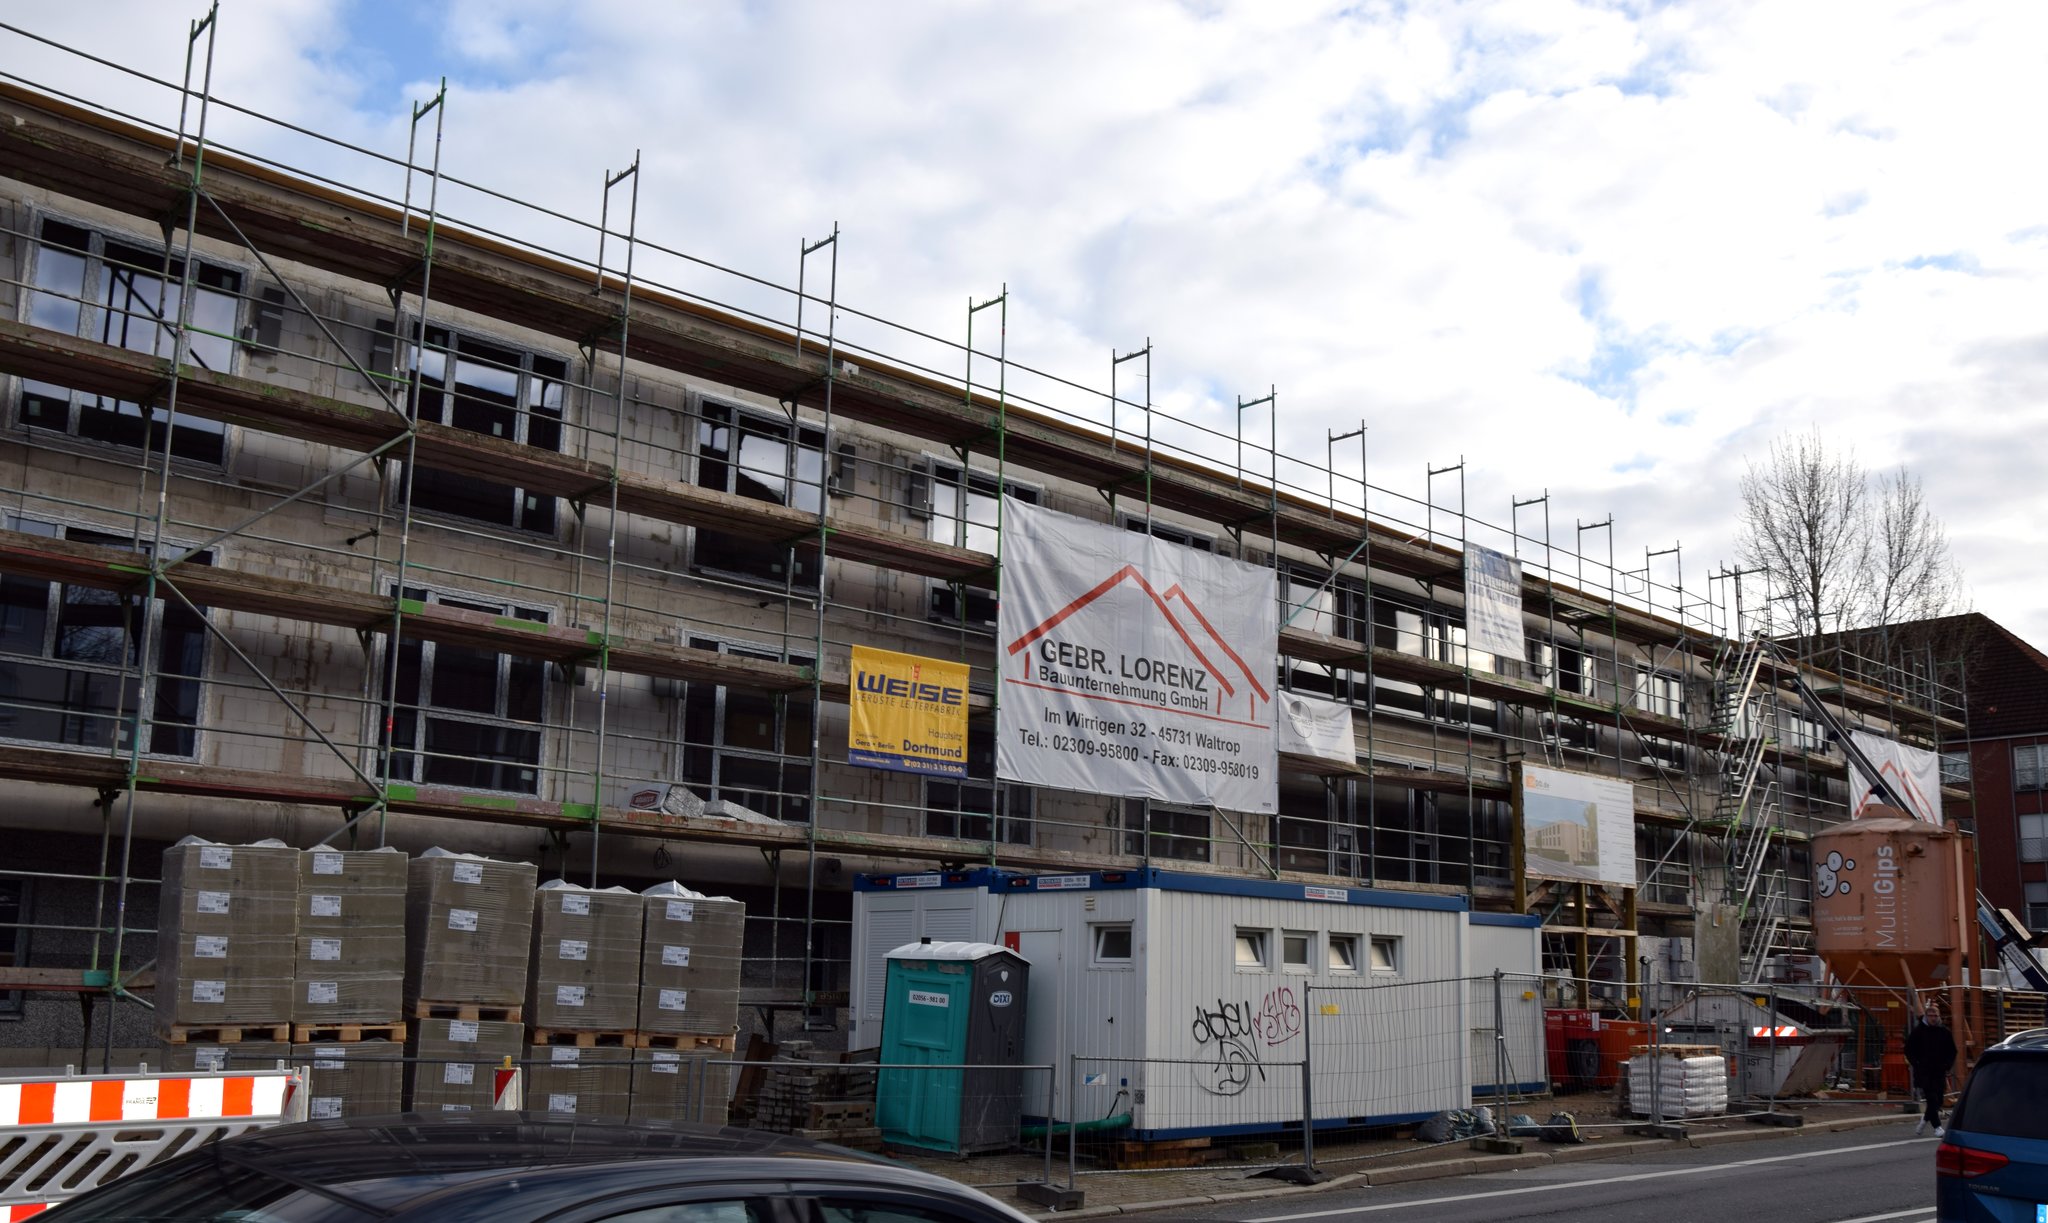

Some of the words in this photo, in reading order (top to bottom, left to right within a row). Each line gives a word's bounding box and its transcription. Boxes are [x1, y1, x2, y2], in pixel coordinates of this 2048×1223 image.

[857, 670, 963, 705] WEISE
[1039, 665, 1166, 706] Bauunternehmung
[1170, 690, 1208, 710] GmbH
[1041, 639, 1112, 675] GEBR.
[1121, 654, 1208, 692] LORENZ
[903, 739, 962, 758] Dortmund
[1019, 728, 1048, 748] Tel.:
[1053, 734, 1139, 761] 02309-95800
[1152, 749, 1180, 768] Fax:
[1183, 754, 1259, 780] 02309-958019
[1044, 706, 1061, 724] Im
[1066, 710, 1126, 736] Wirrigen
[1130, 722, 1147, 737] 32
[1158, 726, 1191, 746] 45731
[1195, 732, 1241, 756] Waltrop
[1873, 846, 1899, 947] MultiGips
[1968, 1183, 2000, 1192] TOURAN
